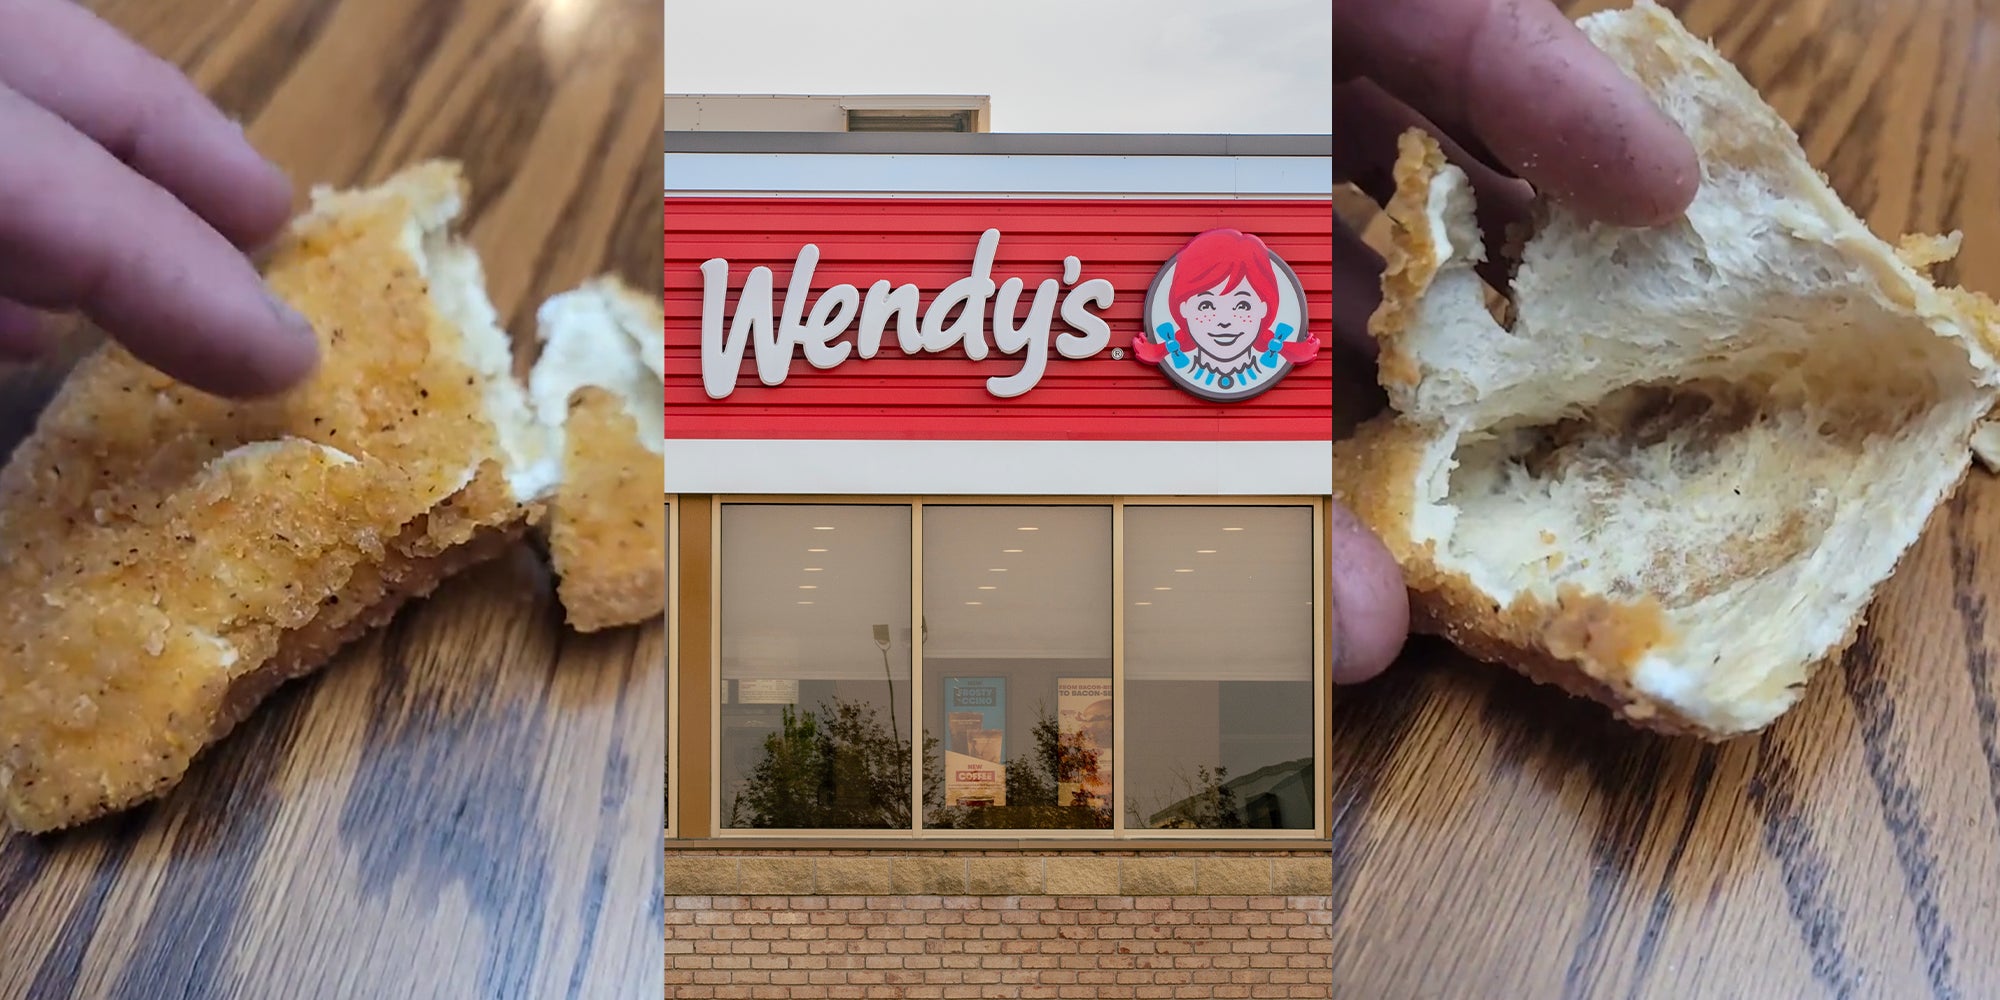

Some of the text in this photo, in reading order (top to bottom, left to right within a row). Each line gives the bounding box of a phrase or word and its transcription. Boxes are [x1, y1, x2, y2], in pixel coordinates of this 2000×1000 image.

[700, 228, 1115, 399] Wendy's
[958, 688, 993, 697] FROSTY
[958, 772, 993, 781] COFFEE
